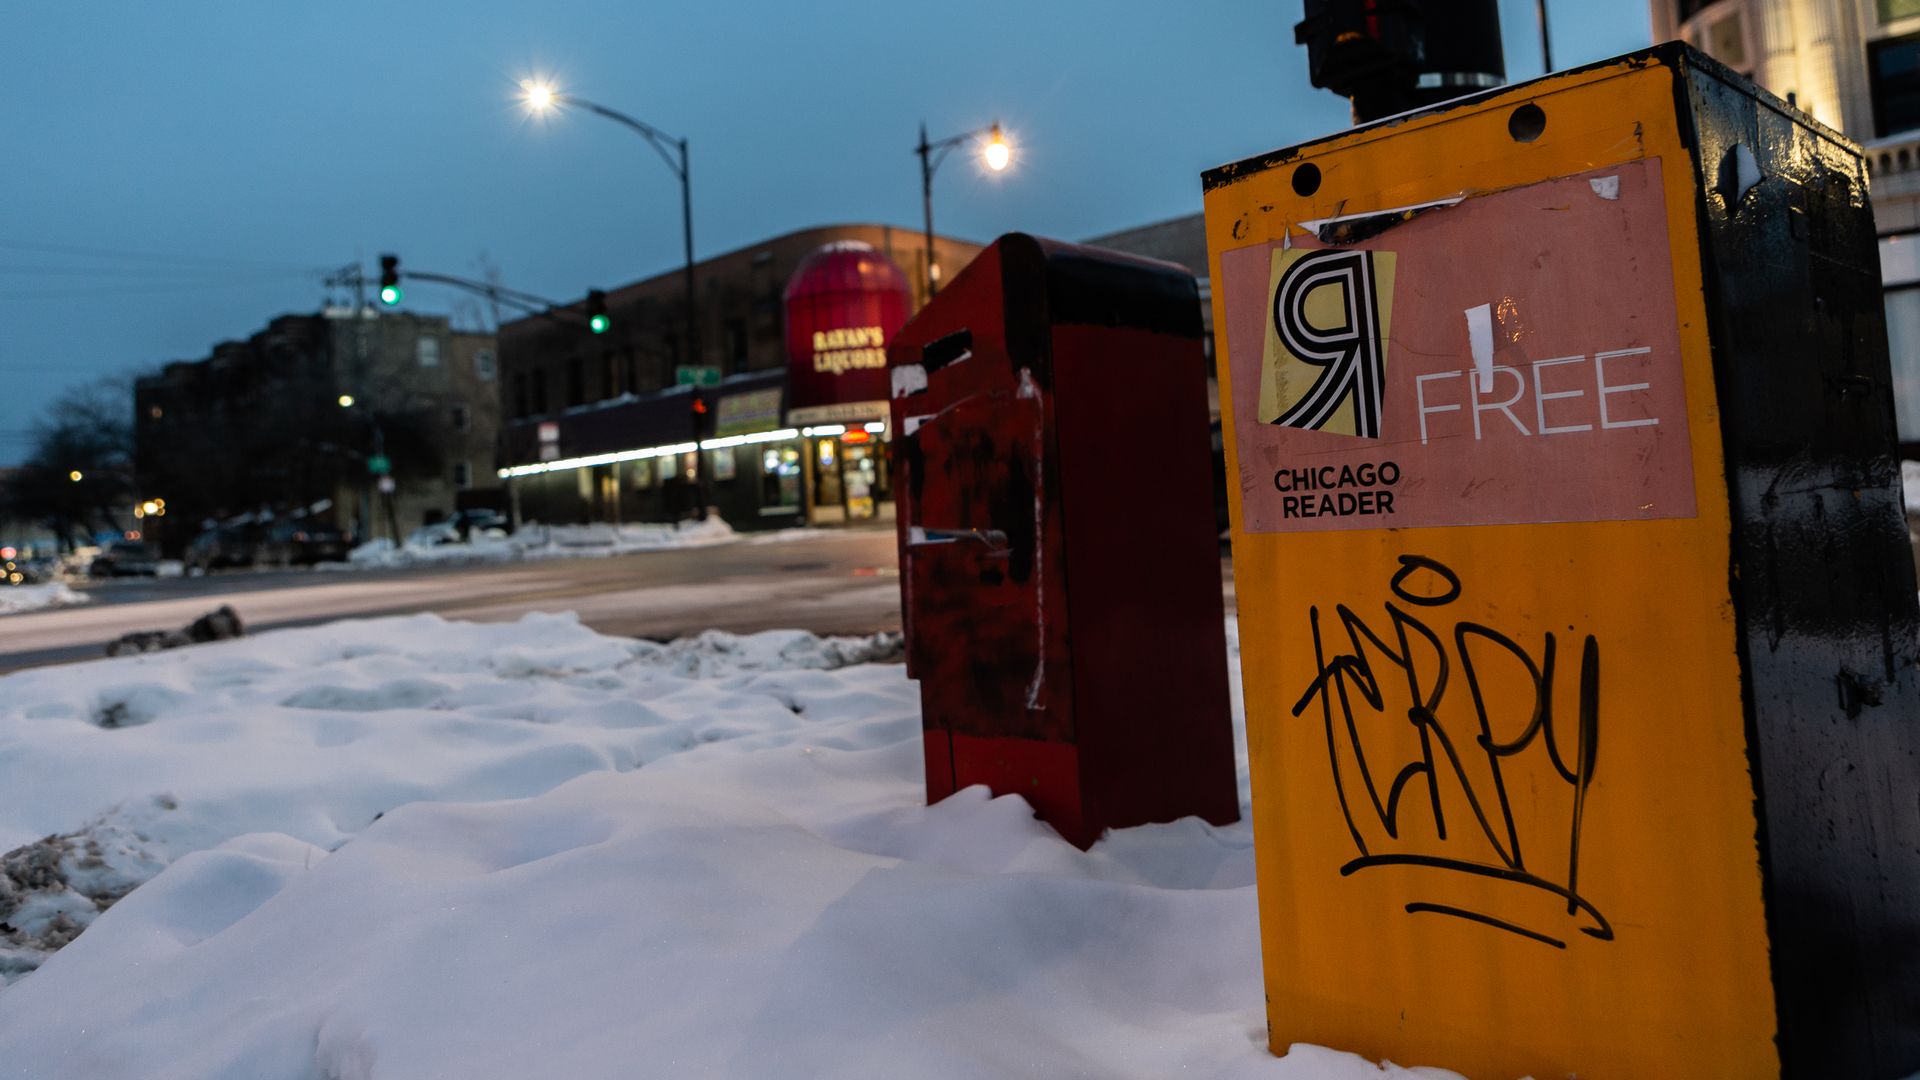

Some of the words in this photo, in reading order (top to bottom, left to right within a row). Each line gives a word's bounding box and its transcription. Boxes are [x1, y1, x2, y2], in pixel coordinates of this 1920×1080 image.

[813, 348, 887, 375] LIQUORS
[1415, 346, 1660, 445] FREE
[1274, 461, 1401, 493] CHICAGO
[1282, 490, 1395, 518] READER
